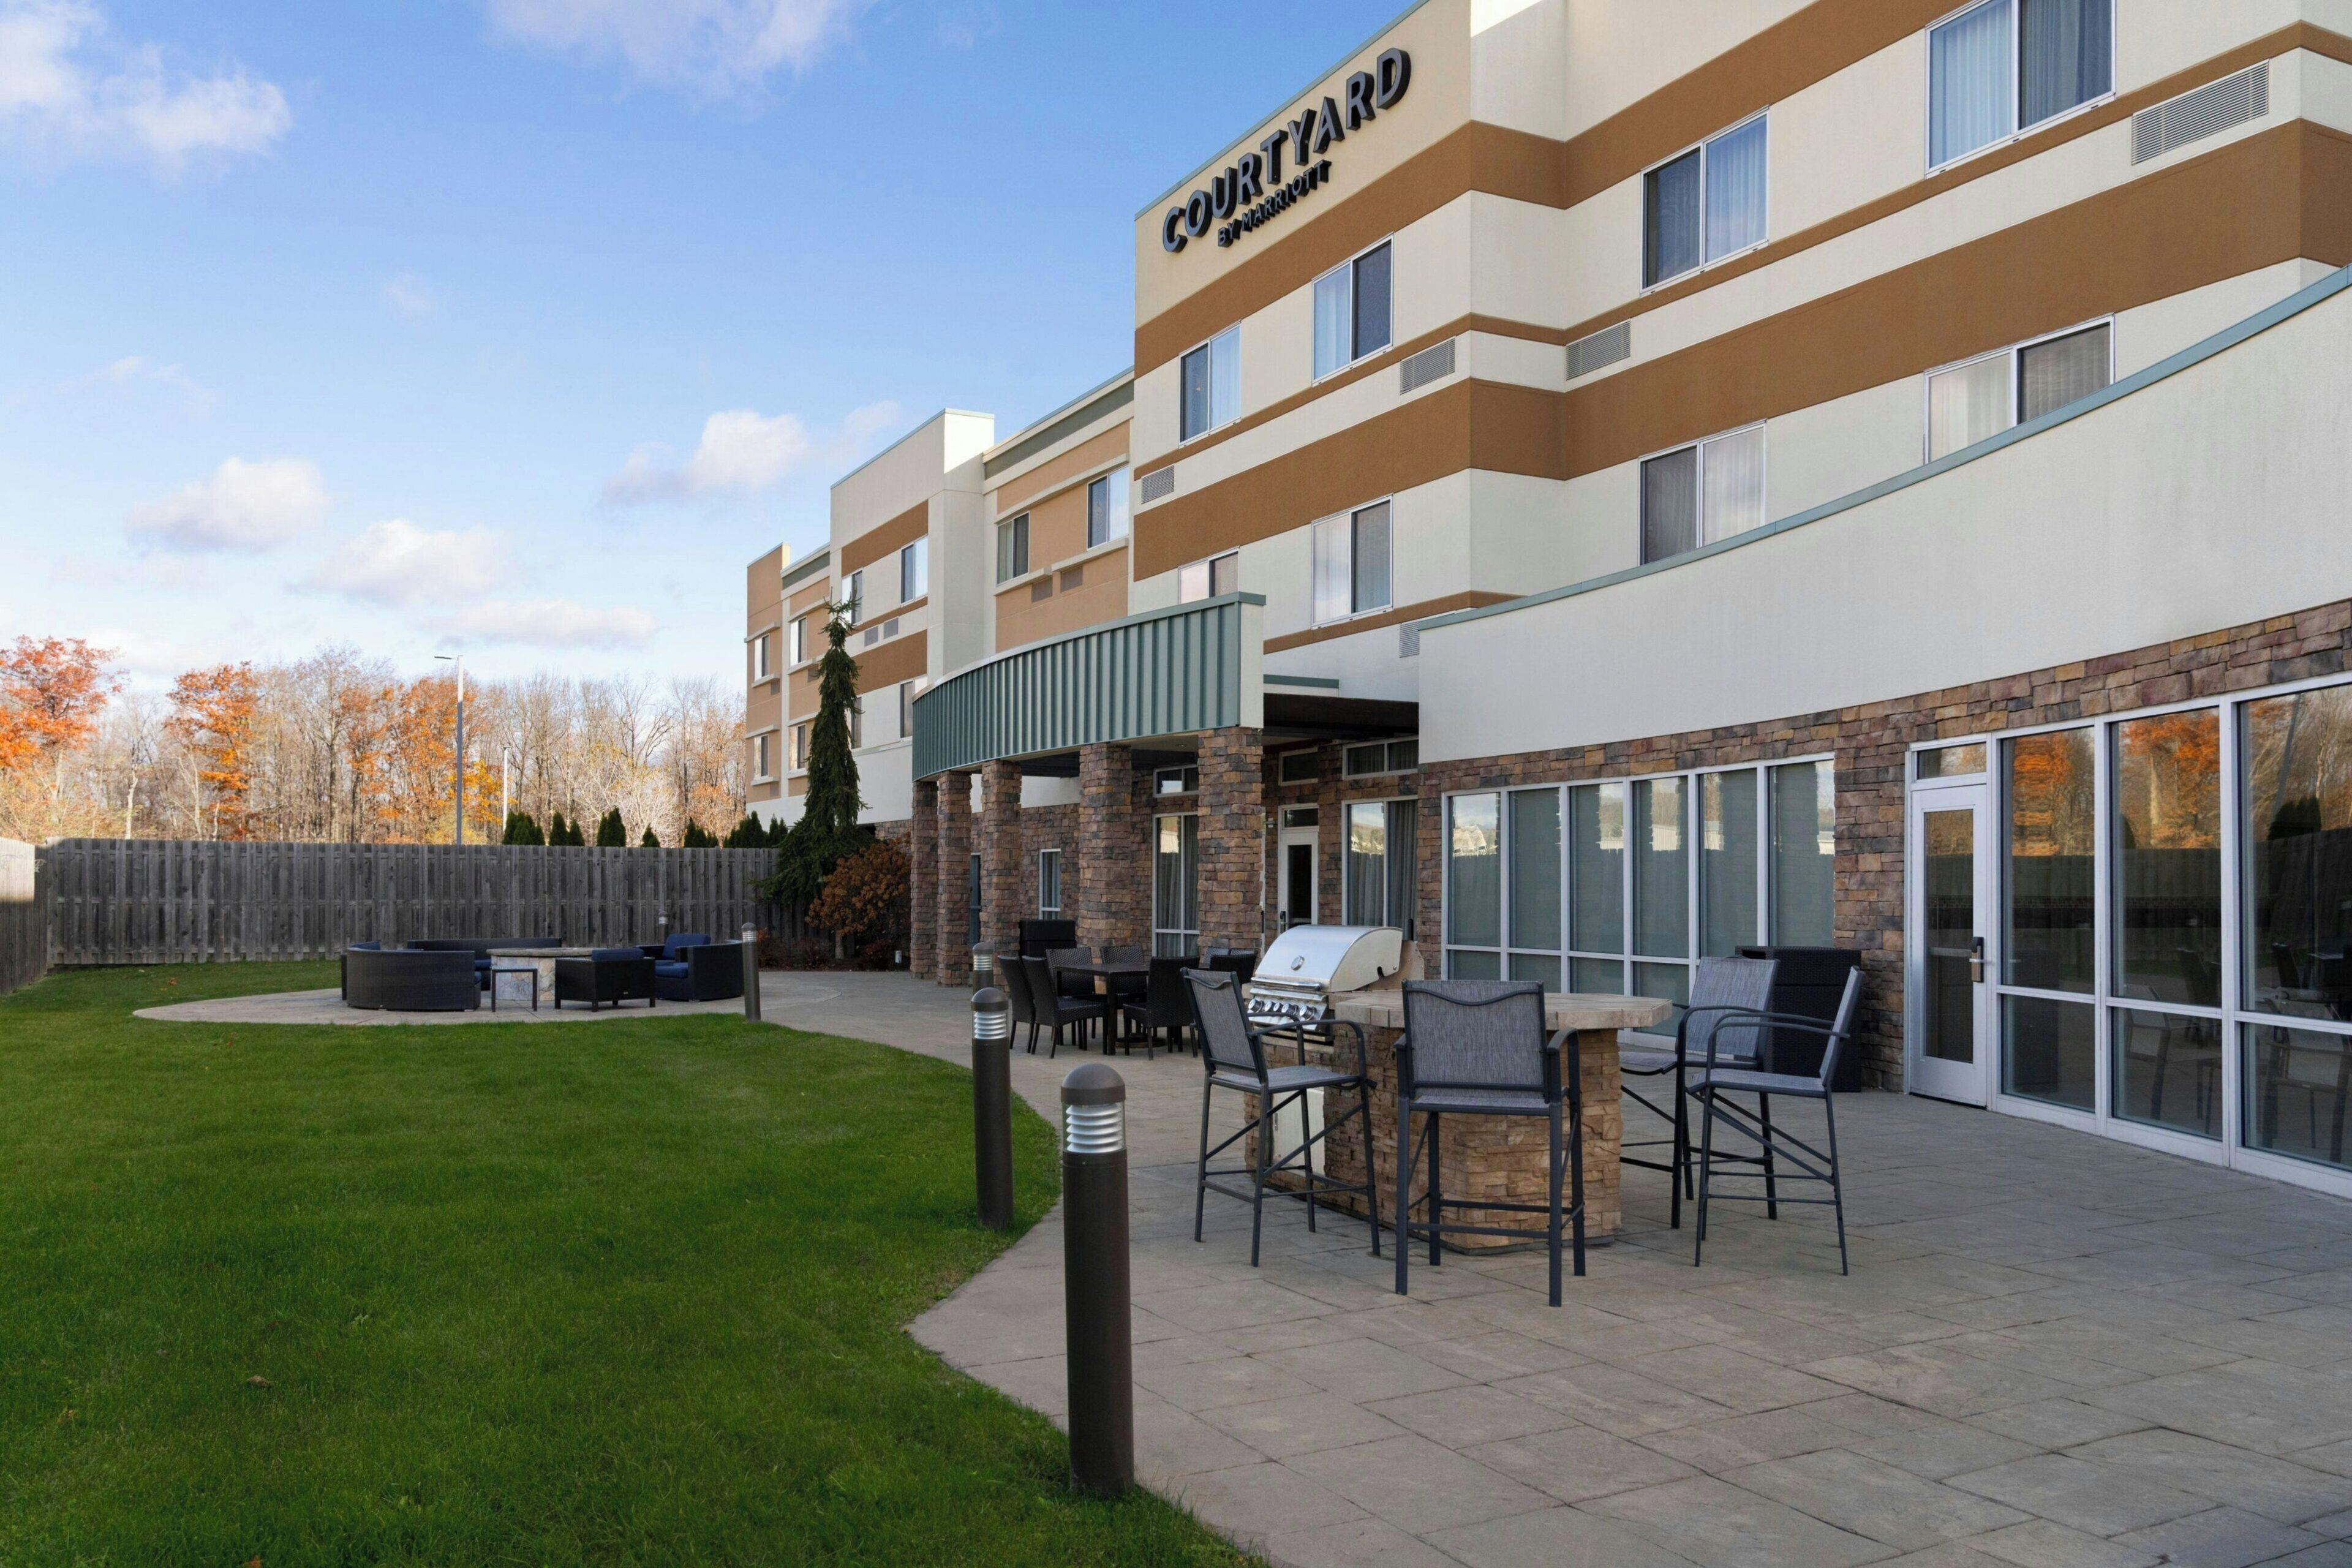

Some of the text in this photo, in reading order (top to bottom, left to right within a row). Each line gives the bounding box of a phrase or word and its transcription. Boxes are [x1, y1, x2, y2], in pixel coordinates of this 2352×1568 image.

[1163, 48, 1411, 252] COURTYARD
[1218, 159, 1332, 247] BY MARRIOTT
